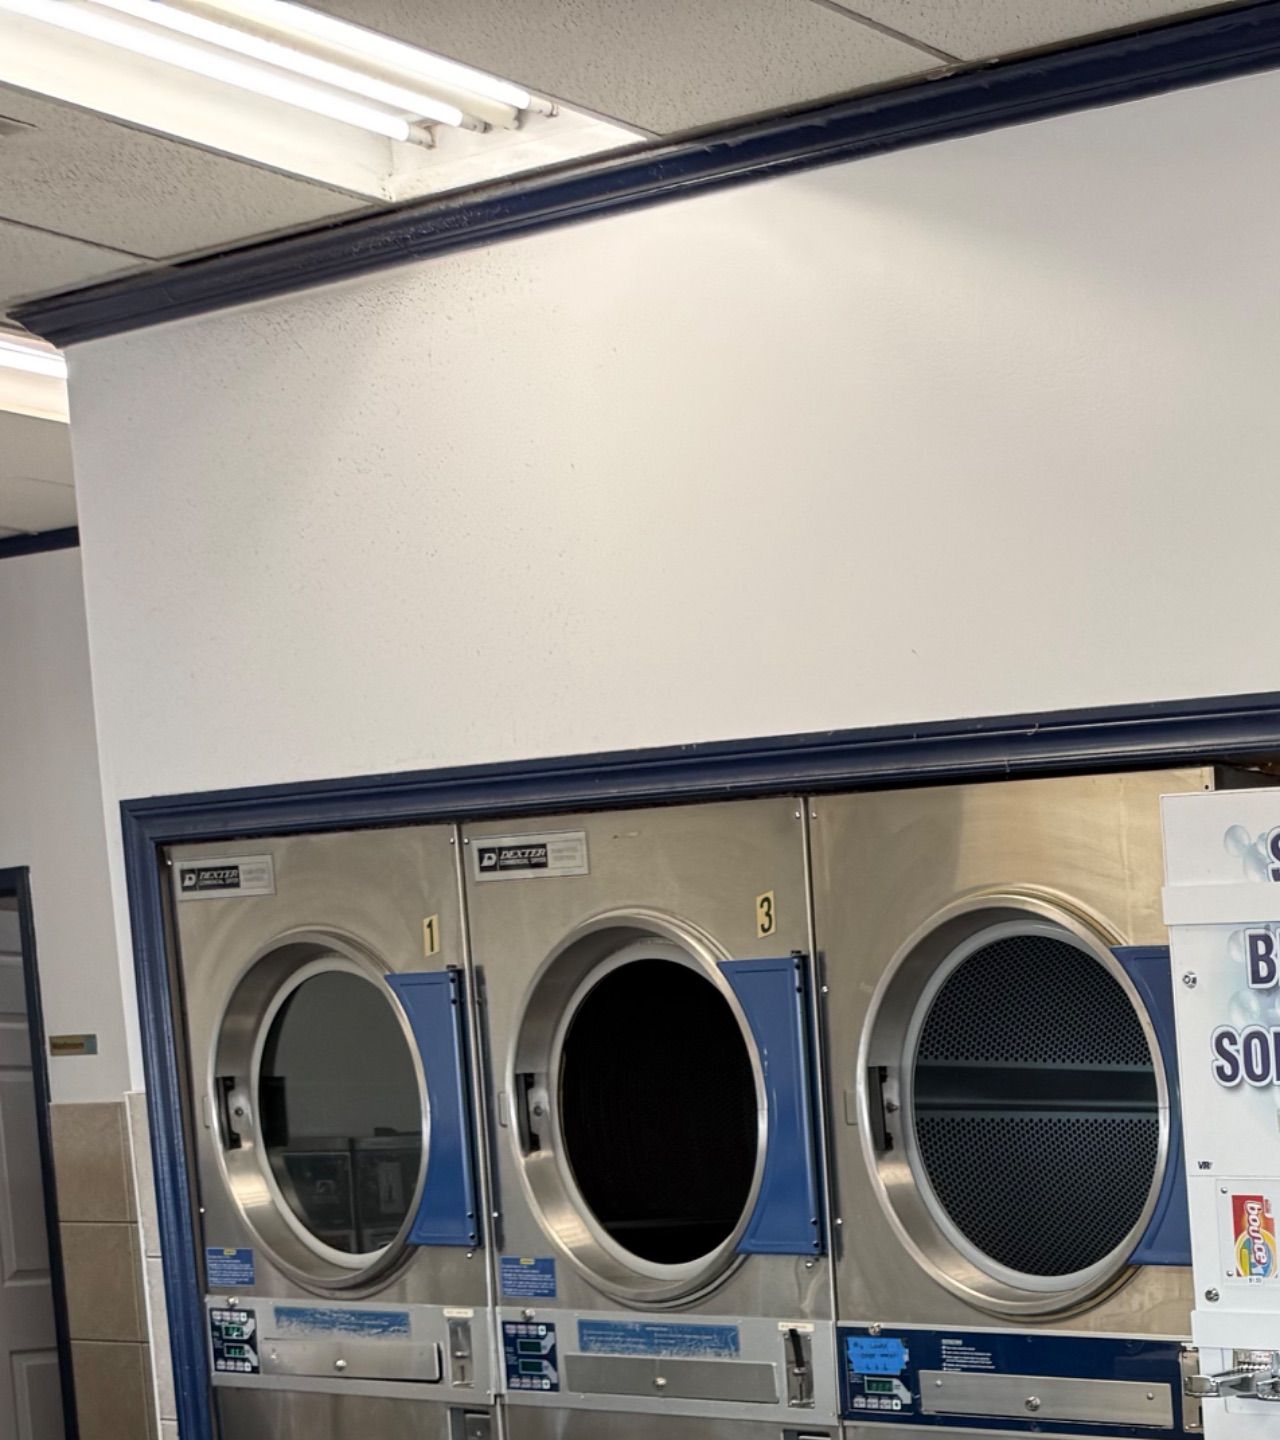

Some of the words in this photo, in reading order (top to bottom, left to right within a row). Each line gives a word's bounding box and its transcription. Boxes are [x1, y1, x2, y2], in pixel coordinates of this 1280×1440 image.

[500, 848, 546, 859] DEXTER
[760, 896, 773, 933] 3
[427, 920, 438, 952] 1
